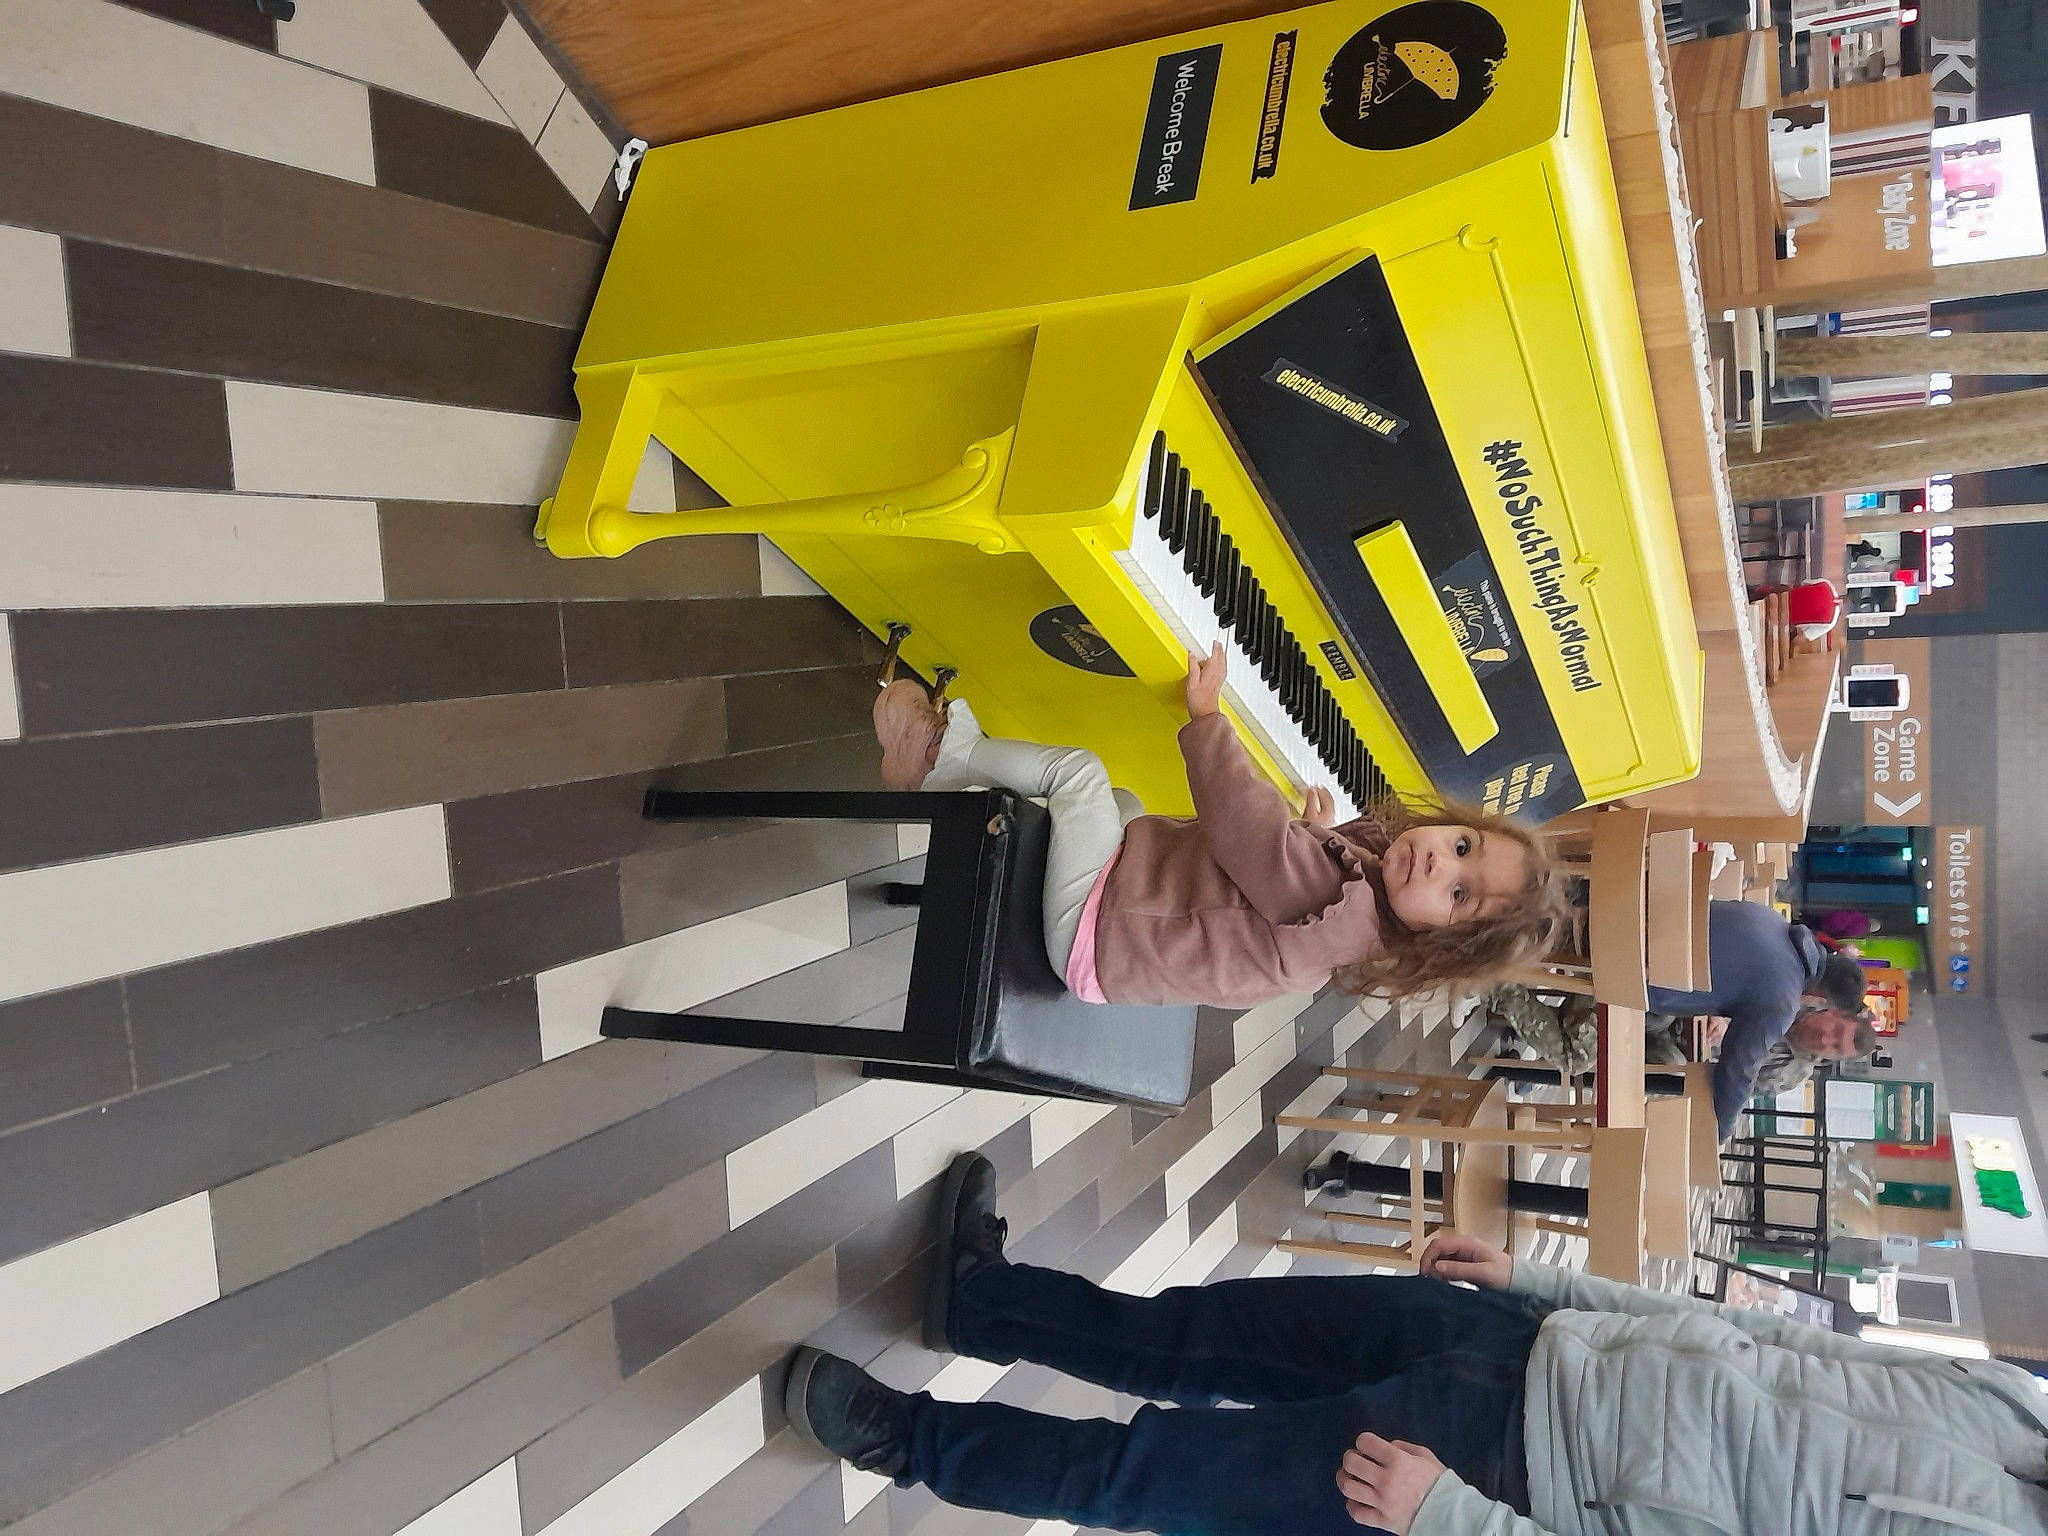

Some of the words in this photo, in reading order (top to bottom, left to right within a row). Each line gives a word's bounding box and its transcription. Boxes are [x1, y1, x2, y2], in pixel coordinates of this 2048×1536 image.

[1163, 59, 1198, 140] Welcome
[1256, 40, 1292, 170] electricumbrella.co.uk
[1357, 61, 1376, 120] UMBRELLA
[1930, 37, 1976, 123] KF
[1154, 140, 1183, 195] Break
[1876, 182, 1914, 214] Baby
[1884, 214, 1917, 251] Zone
[1275, 368, 1397, 436] electricumbrella.co.uk
[1482, 439, 1602, 693] #NoSuchThingAsNormal
[1529, 763, 1555, 799] Please
[1873, 726, 1896, 783] Zone
[1898, 717, 1922, 782] Game
[1948, 829, 1971, 899] Toilets
